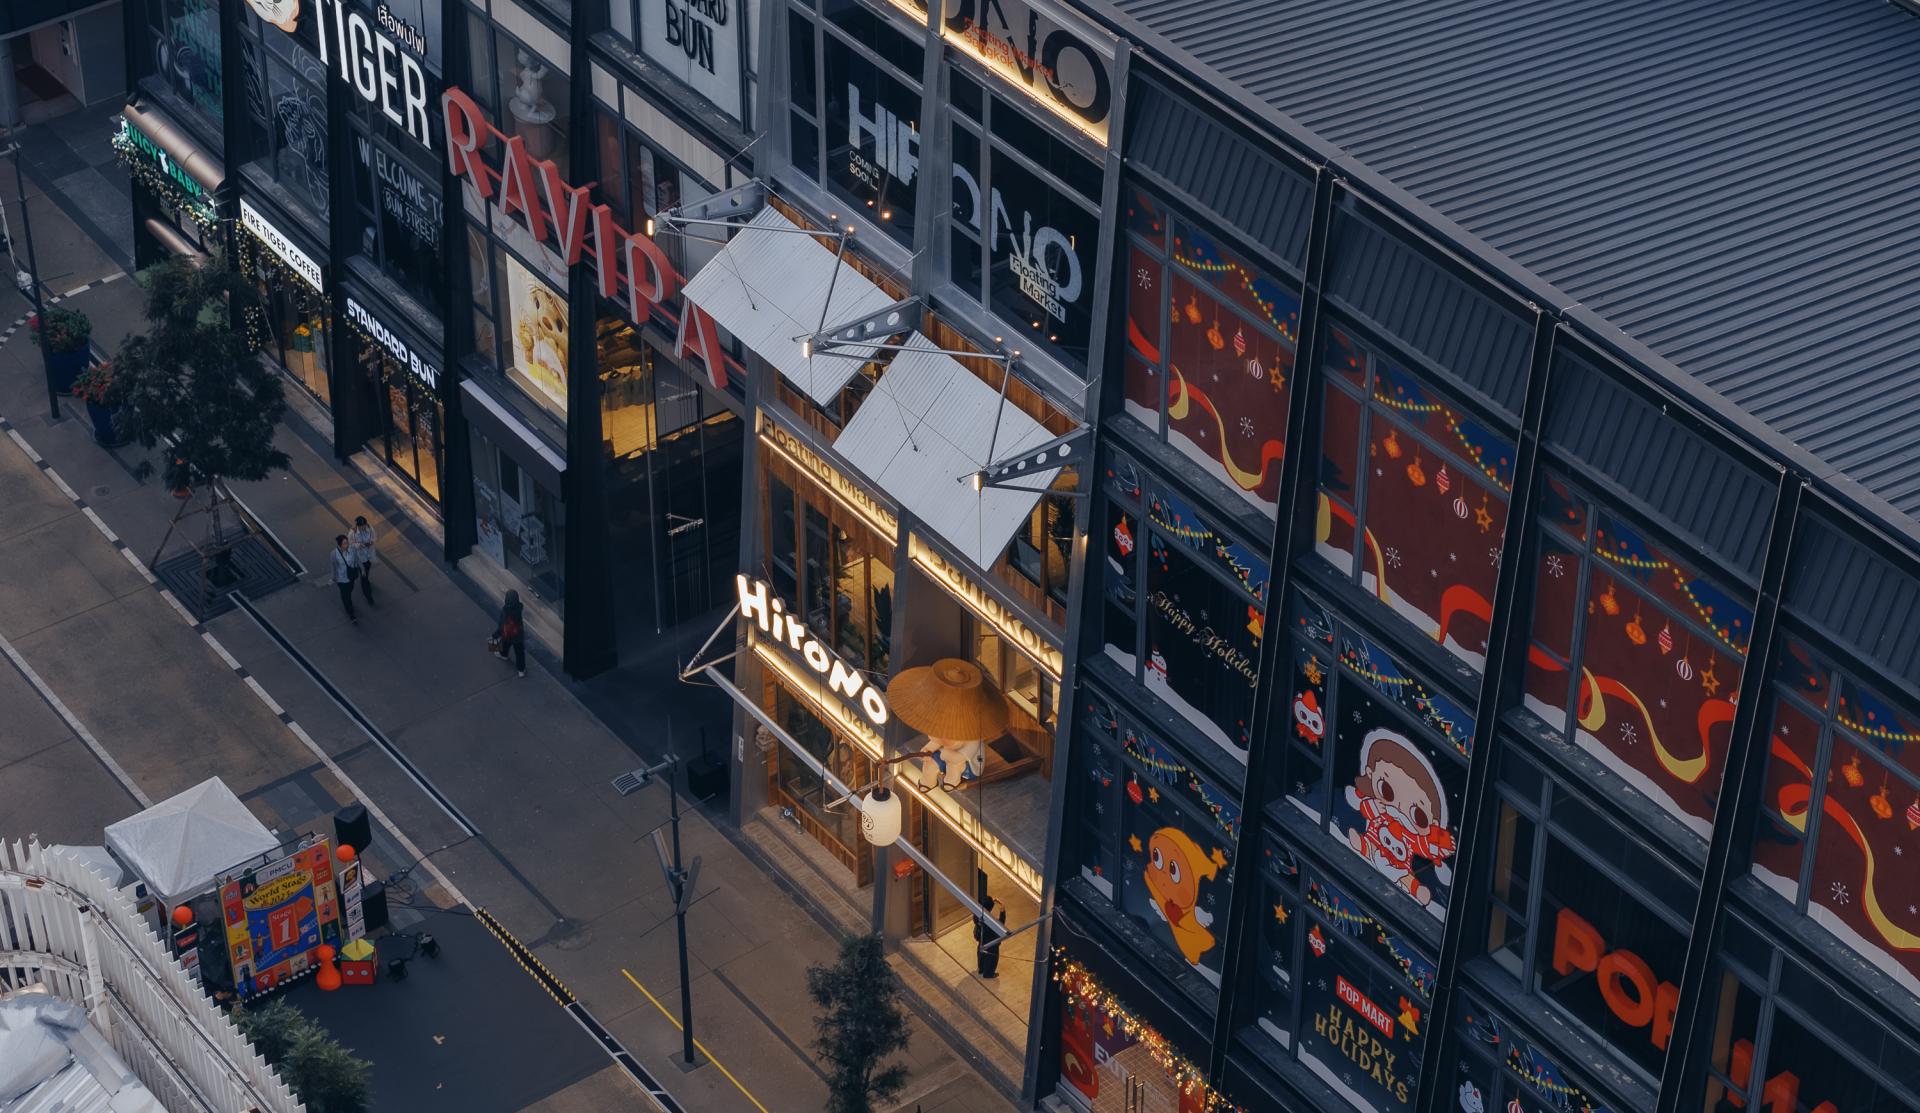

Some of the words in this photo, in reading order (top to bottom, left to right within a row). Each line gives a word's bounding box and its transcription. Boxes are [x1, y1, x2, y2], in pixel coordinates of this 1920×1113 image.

[665, 0, 715, 75] BUN
[315, 0, 431, 150] TIGER
[168, 160, 200, 197] BABY
[358, 136, 427, 211] WELCOME
[243, 208, 261, 232] FIRE
[262, 224, 287, 255] TIGER
[289, 249, 321, 285] COFFEE
[442, 86, 728, 391] RAVIPA
[1013, 257, 1057, 299] Floating
[1023, 278, 1064, 318] Market
[347, 297, 408, 363] STANDARD
[410, 350, 436, 389] BUN
[1155, 591, 1196, 635] Happy
[249, 887, 280, 905] World
[280, 918, 291, 943] 1
[1330, 1004, 1396, 1072] HAPPY
[1339, 980, 1360, 1004] POP
[1361, 999, 1391, 1033] MART
[1315, 1012, 1408, 1104] HOLIDAYS
